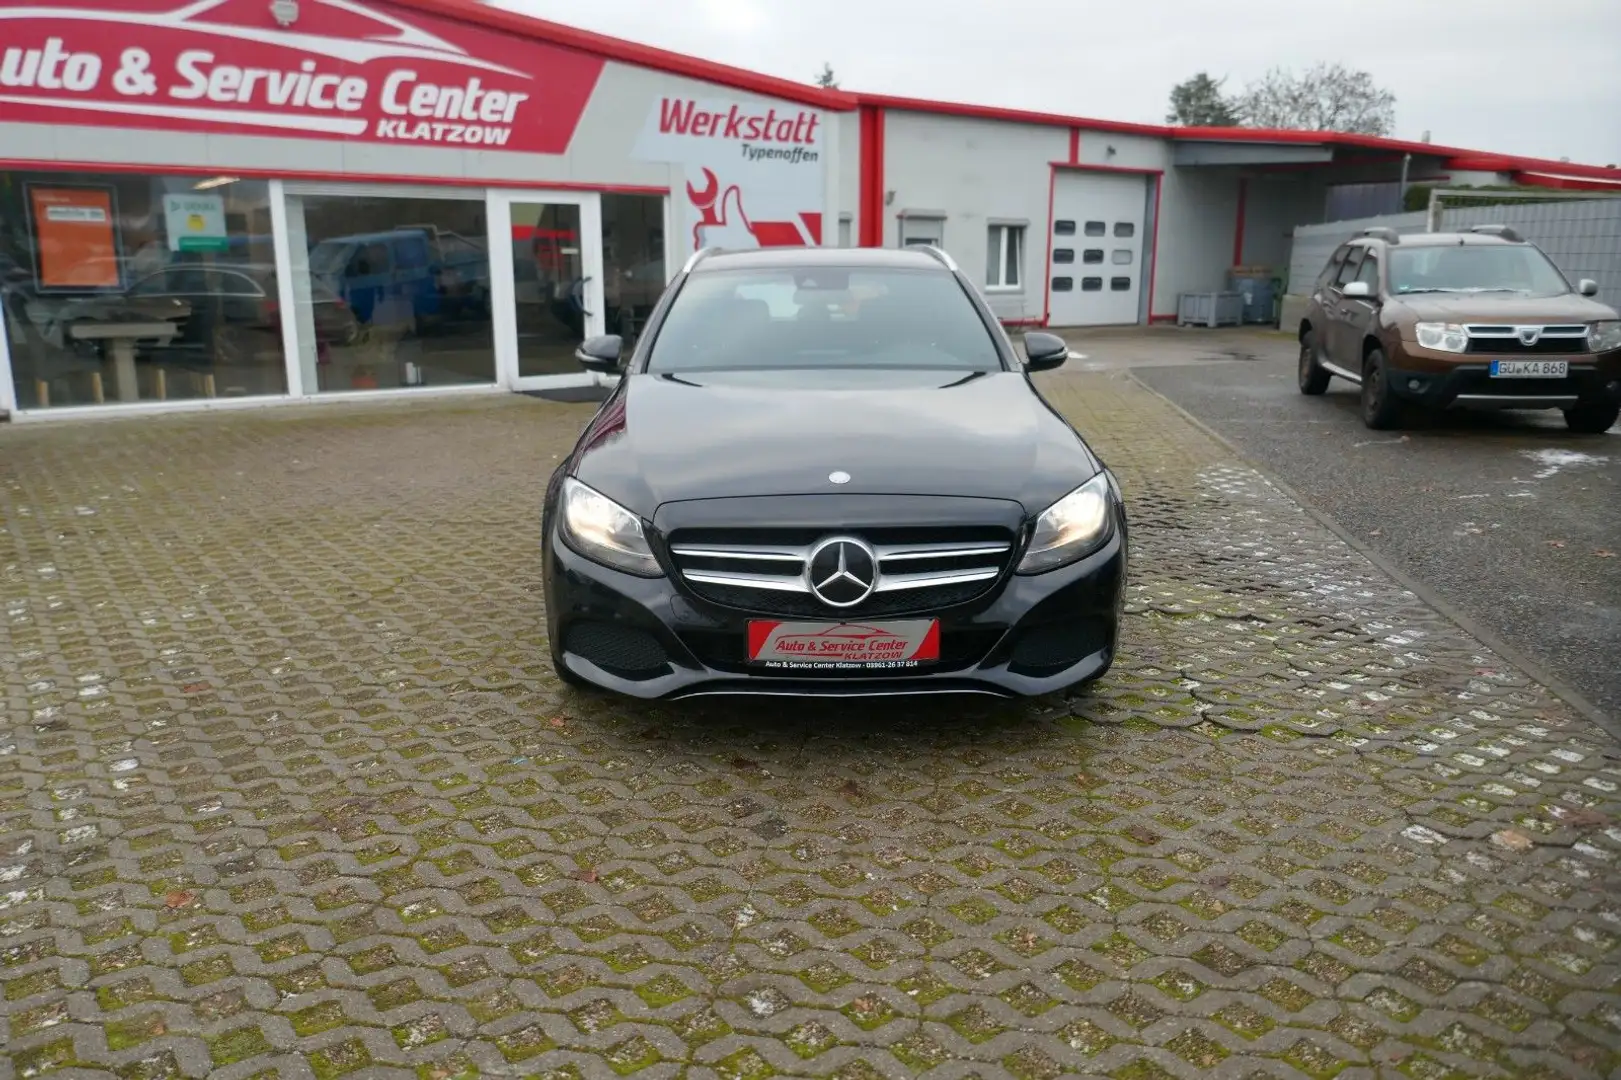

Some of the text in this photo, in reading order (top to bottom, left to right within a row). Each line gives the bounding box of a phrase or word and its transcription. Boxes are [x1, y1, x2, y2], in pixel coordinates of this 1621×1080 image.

[0, 37, 529, 123] uto & Service Center
[659, 98, 820, 144] Werkstatt
[376, 119, 511, 145] KLATZOW
[741, 143, 818, 163] Typenoffen
[1523, 362, 1540, 374] KA
[1542, 362, 1566, 374] 868
[776, 640, 908, 651] Auto & Service Center
[844, 652, 902, 660] KLATZOW
[789, 661, 813, 669] Service
[813, 661, 835, 669] Center
[835, 661, 861, 669] Klatzow
